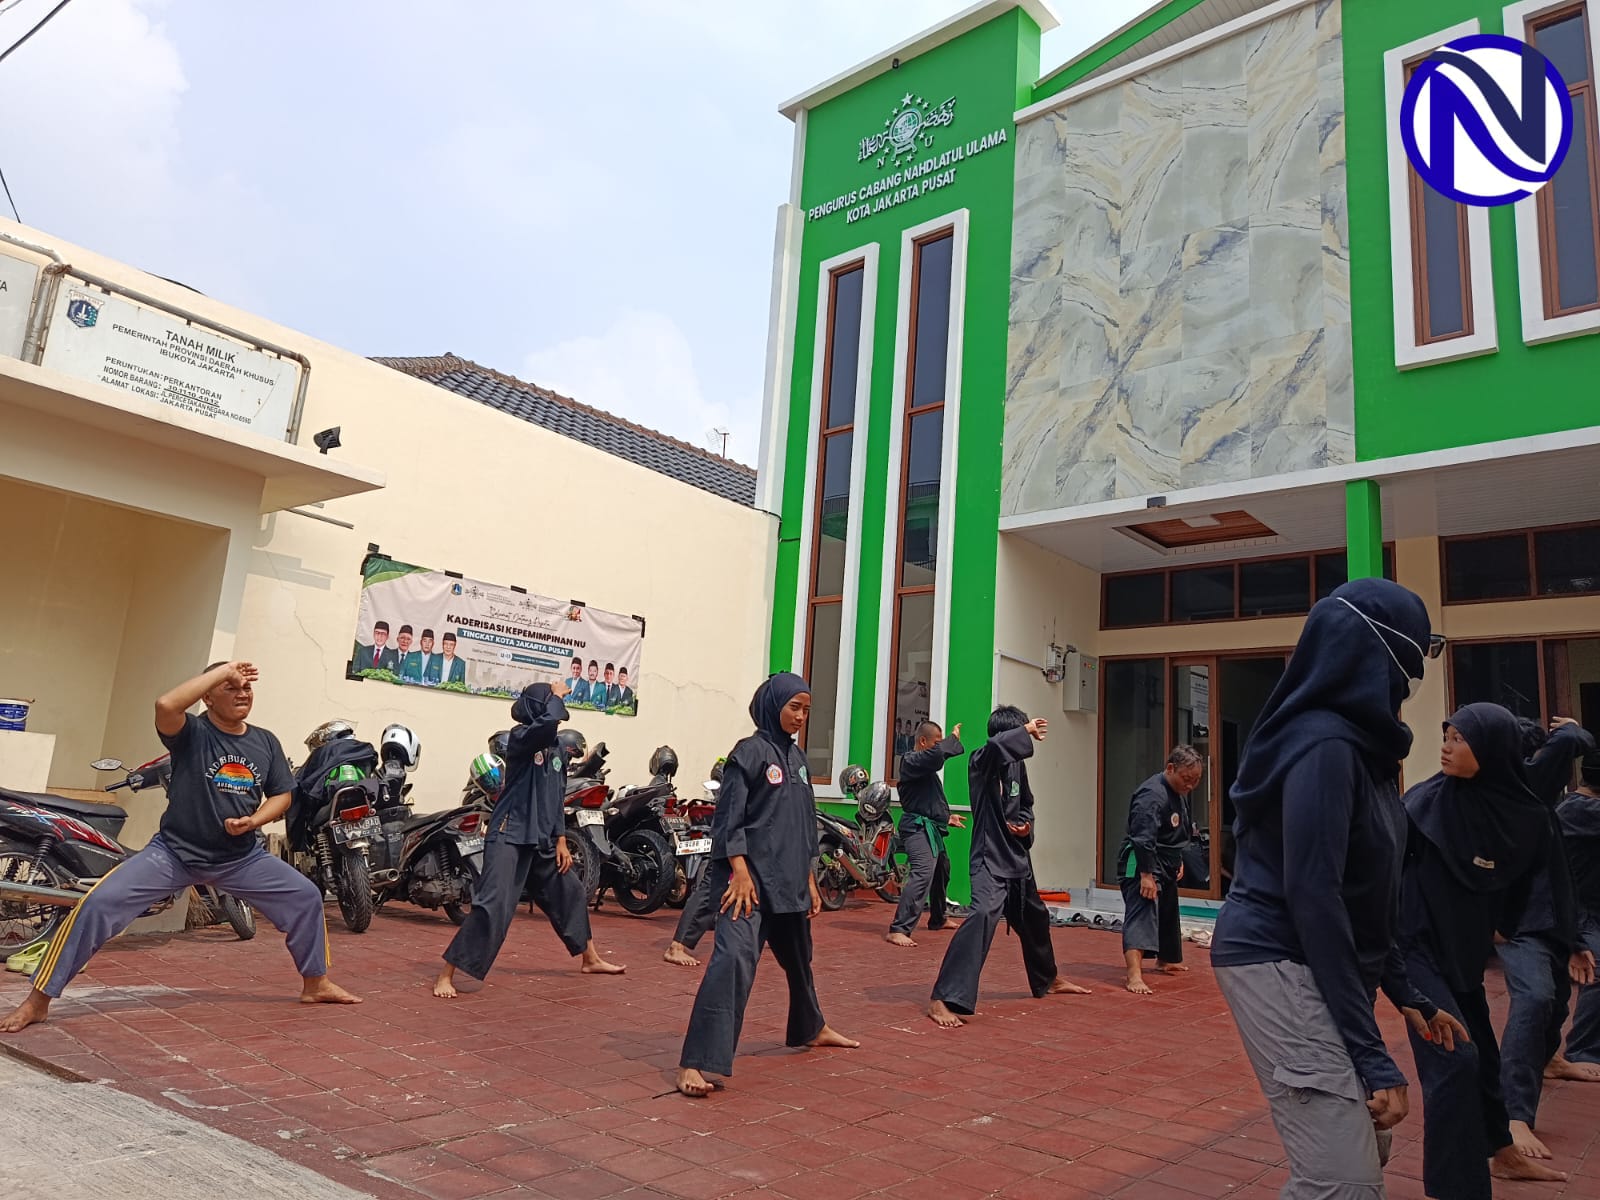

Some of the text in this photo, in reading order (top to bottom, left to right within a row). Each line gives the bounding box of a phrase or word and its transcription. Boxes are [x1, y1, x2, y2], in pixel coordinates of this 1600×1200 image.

[808, 128, 1007, 221] PENGURUS CABANG NAHDLATUL ULAMA
[846, 168, 957, 224] KOTA JAKARTA PUSAT
[112, 323, 274, 386] PEMERINTAH PROVINSI DAERAH KHUSUS
[165, 330, 236, 364] TANAH MILIK
[103, 365, 129, 379] NOMOR
[159, 348, 235, 380] IBUKOTA JAKARTA
[101, 375, 129, 389] ALAMAT
[163, 375, 222, 400] PERKANTORAN
[160, 398, 217, 420] JAKARTA PUSAT
[446, 613, 586, 649] KADERISASI KEPEMIMPINAN NU
[462, 630, 569, 656] TINGKAT KOTA JAKARTA PUSAT
[247, 762, 262, 786] ALAM
